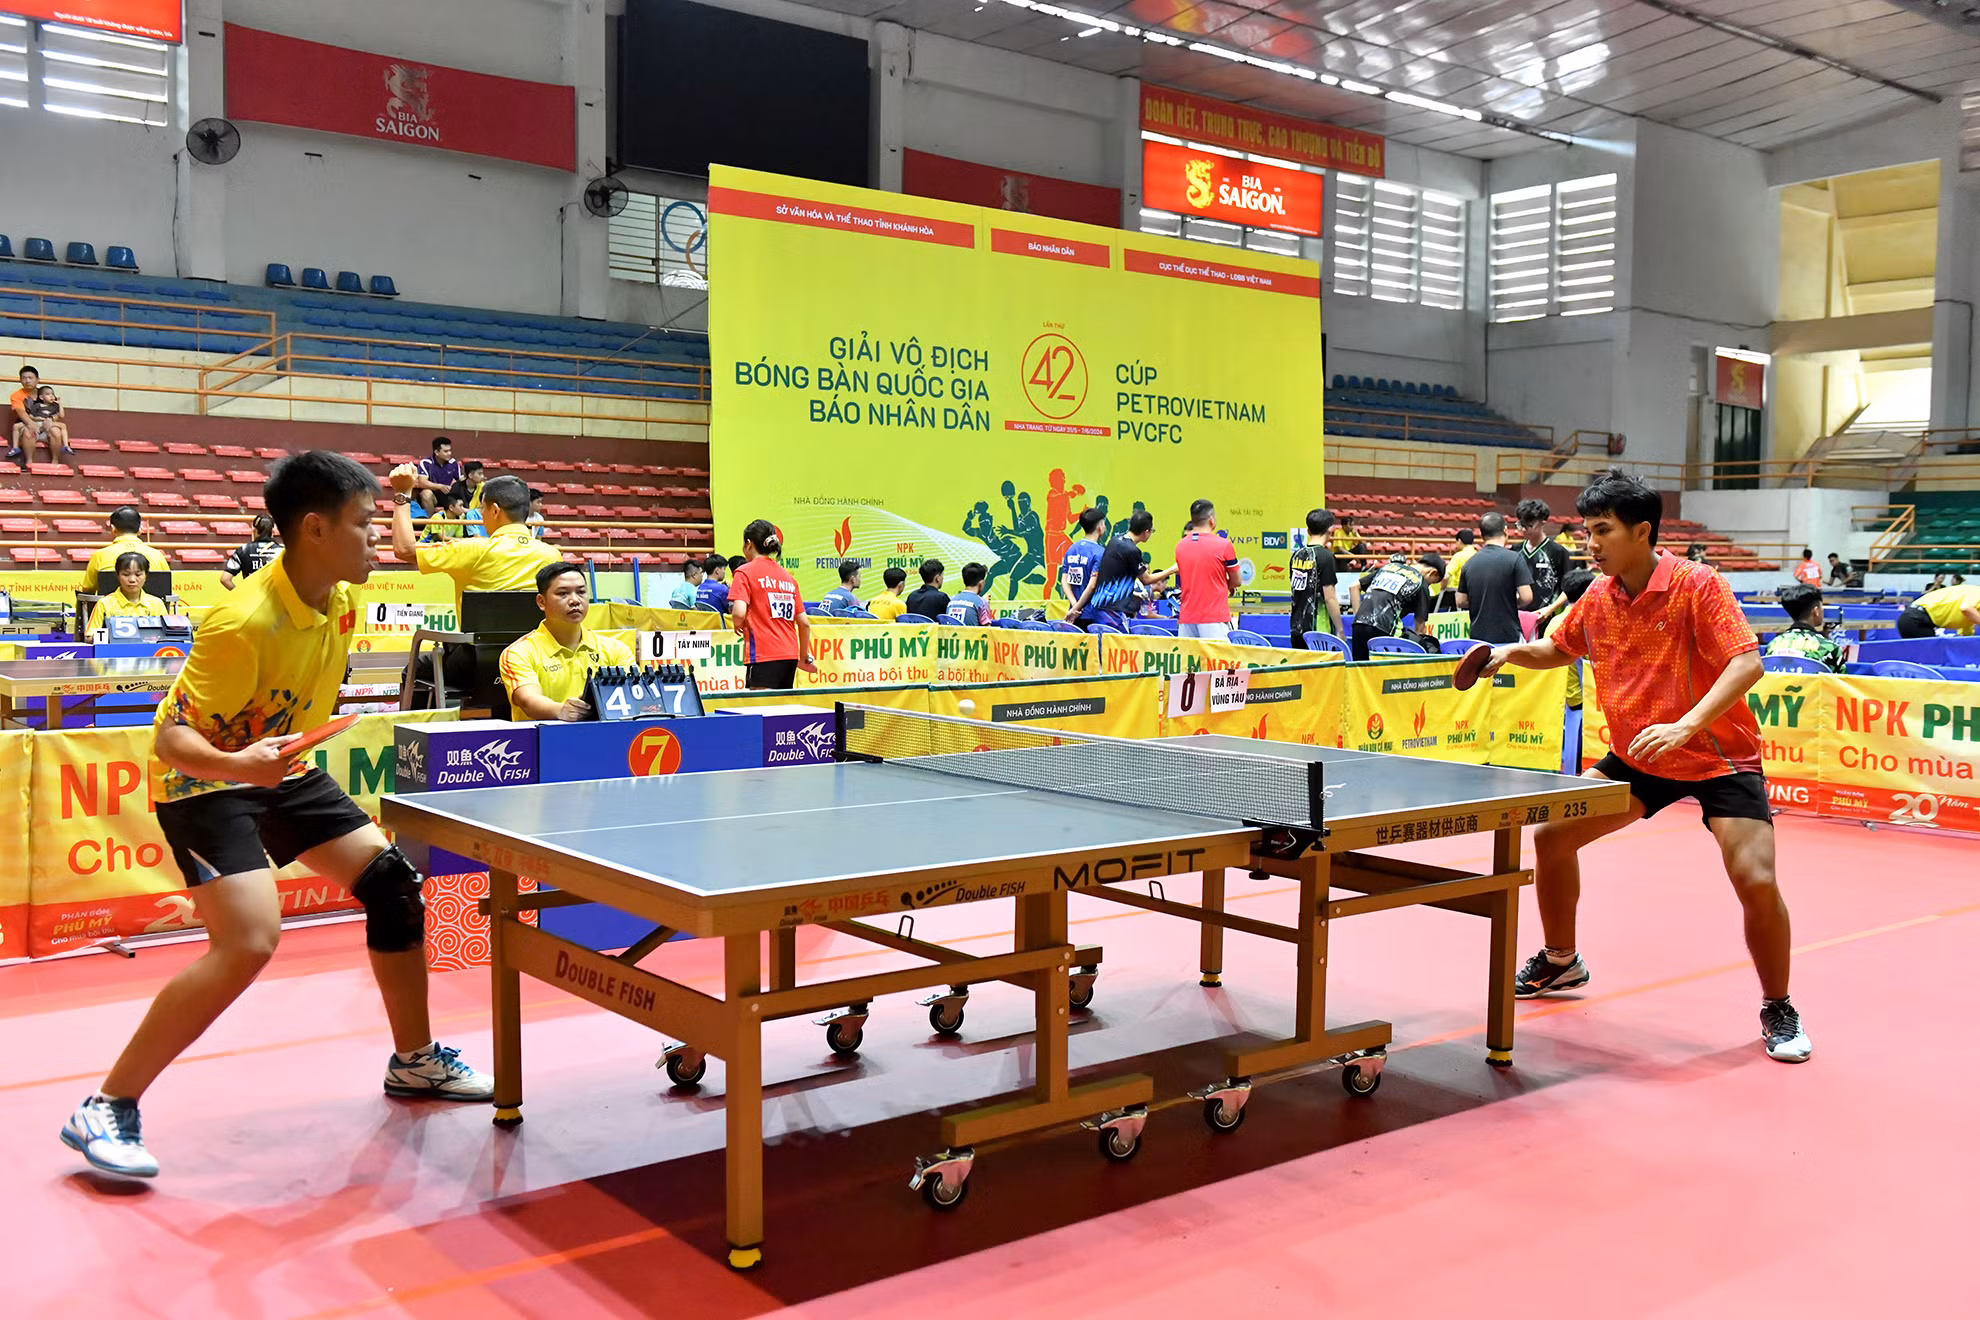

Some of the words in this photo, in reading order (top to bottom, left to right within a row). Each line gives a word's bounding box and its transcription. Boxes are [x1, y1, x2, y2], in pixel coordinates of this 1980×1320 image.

[398, 111, 418, 123] BIA
[375, 117, 440, 142] SAIGON
[1241, 175, 1262, 191] BIA
[806, 207, 823, 220] HÓA
[824, 212, 835, 221] VÀ
[853, 217, 874, 227] THAO
[893, 222, 918, 233] KHÁNH
[919, 225, 934, 236] HÒA
[1028, 241, 1042, 252] BÁO
[1210, 269, 1226, 279] THAO
[1259, 277, 1272, 286] NAM
[829, 330, 881, 363] GIẢI
[890, 335, 923, 366] VÔ
[930, 345, 989, 374] ĐỊCH
[735, 355, 810, 389] BÓNG
[818, 361, 869, 393] BÀN
[876, 364, 944, 399] QUỐC
[950, 378, 990, 402] GIA
[1029, 345, 1075, 401] 42
[1115, 359, 1158, 386] CÚP
[810, 393, 861, 425] BÁO
[868, 397, 936, 429] NHÂN
[943, 401, 991, 432] DÂN
[1116, 391, 1266, 424] PETROVIETNAM
[1117, 420, 1183, 444] PVCFC
[793, 496, 811, 505] NHÀ
[837, 496, 859, 505] HÀNH
[860, 497, 884, 506] CHÍNH
[896, 543, 914, 553] NPK
[1229, 536, 1259, 545] VNPT
[1263, 536, 1280, 546] BIDV
[887, 554, 907, 568] PHÚ
[8, 582, 32, 592] TỈNH
[32, 582, 68, 592] KHÁNH
[184, 583, 202, 592] DÂN
[377, 582, 394, 591] VIỆT
[396, 583, 414, 591] NAM
[758, 575, 777, 589] TÂY
[376, 604, 387, 622] 0
[115, 617, 137, 637] 5
[1438, 618, 1460, 639] PHÚ
[652, 633, 664, 658] 0
[677, 639, 690, 649] TÂY
[692, 640, 710, 649] NINH
[850, 632, 892, 660] PHÚ
[900, 630, 930, 659] MỸ
[994, 640, 1020, 666] NPK
[1024, 640, 1057, 670] PHÚ
[1062, 641, 1089, 671] MỸ
[1107, 648, 1139, 673] NPK
[1144, 647, 1181, 675] PHÚ
[808, 668, 838, 684] Cho
[843, 669, 875, 683] mùa
[880, 667, 902, 683] bội
[907, 666, 929, 681] thu
[948, 668, 966, 683] bội
[970, 669, 989, 683] thu
[1215, 675, 1225, 688] BÀ
[1226, 676, 1239, 689] RỊA
[147, 684, 171, 693] Double
[1391, 681, 1402, 690] NHÀ
[605, 686, 632, 716] 4
[632, 685, 644, 699] 0
[649, 684, 661, 698] 1
[663, 685, 686, 713] 7
[1212, 693, 1230, 706] VŨNG
[1231, 691, 1245, 704] TÀU
[1255, 691, 1274, 701] HÀNH
[1274, 690, 1292, 699] CHÍNH
[1006, 707, 1023, 718] NHÀ
[1025, 705, 1045, 717] ĐỒNG
[1046, 704, 1068, 715] HÀNH
[1068, 702, 1092, 713] CHÍNH
[1747, 685, 1806, 728] MỸ
[1455, 720, 1469, 730] NPK
[1836, 696, 1911, 737] NPK
[1518, 720, 1535, 731] NPK
[1301, 732, 1315, 744] NPK
[1402, 736, 1438, 750] PETROVIETNAM
[1447, 732, 1463, 744] PHÚ
[1464, 730, 1477, 742] MỸ
[1509, 731, 1528, 744] PHÚ
[1530, 732, 1544, 745] MỸ
[641, 735, 670, 776] 7
[768, 749, 806, 762] Double
[1761, 741, 1803, 764] thu
[1839, 745, 1898, 772] Cho
[1909, 755, 1973, 780] mùa
[395, 763, 411, 780] Double
[417, 772, 427, 784] FISH
[437, 769, 485, 785] Double
[503, 768, 531, 780] FISH
[60, 761, 156, 819] NP
[1563, 801, 1587, 818] 235
[1832, 795, 1853, 807] PHÚ
[1889, 793, 1940, 823] 20
[1524, 805, 1549, 825] 双鱼
[1376, 814, 1478, 845] 世乒赛器材供应商
[68, 837, 164, 875] Cho
[1053, 847, 1205, 892] MOFIT
[956, 884, 998, 903] Double
[1000, 881, 1026, 896] FISH
[53, 918, 85, 935] PHÚ
[51, 937, 69, 945] Cho
[619, 981, 656, 1012] FISH
